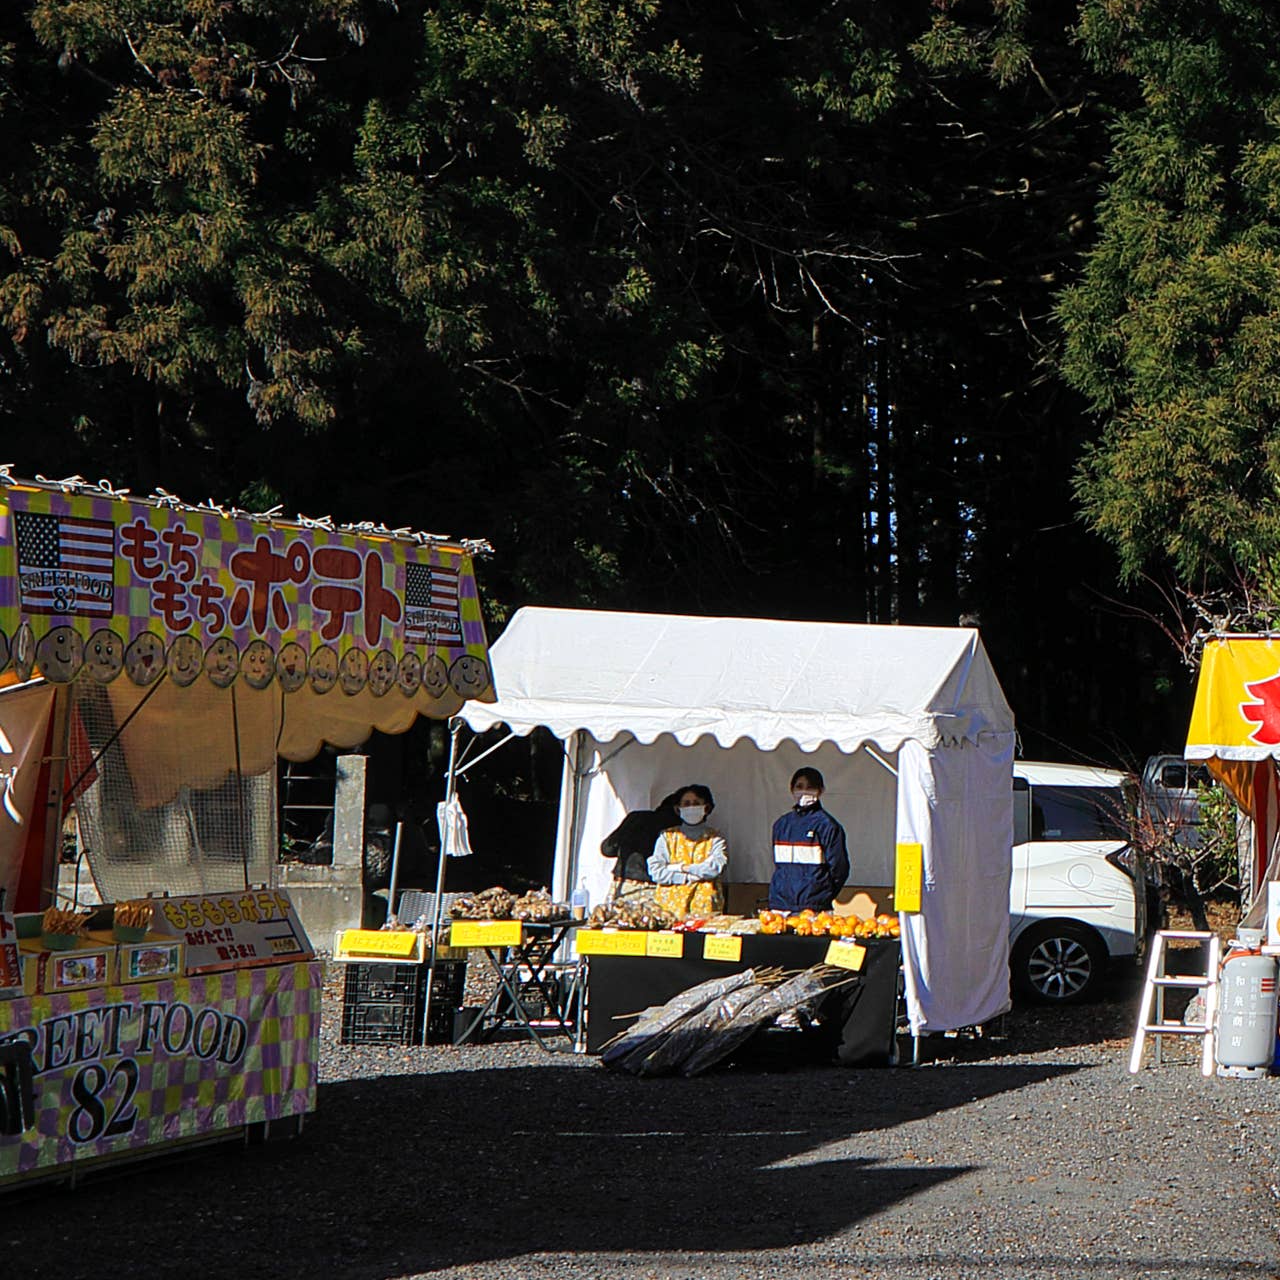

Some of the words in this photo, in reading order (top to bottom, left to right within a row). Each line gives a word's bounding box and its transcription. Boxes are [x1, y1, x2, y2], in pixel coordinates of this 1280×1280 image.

[120, 515, 201, 580] もち
[51, 587, 77, 612] 82
[74, 573, 112, 600] FOOD
[152, 572, 228, 636] もち
[228, 535, 403, 647] ポテト
[162, 893, 290, 929] もちもちポテト
[138, 1001, 247, 1066] FOOD
[67, 1057, 141, 1146] 82
